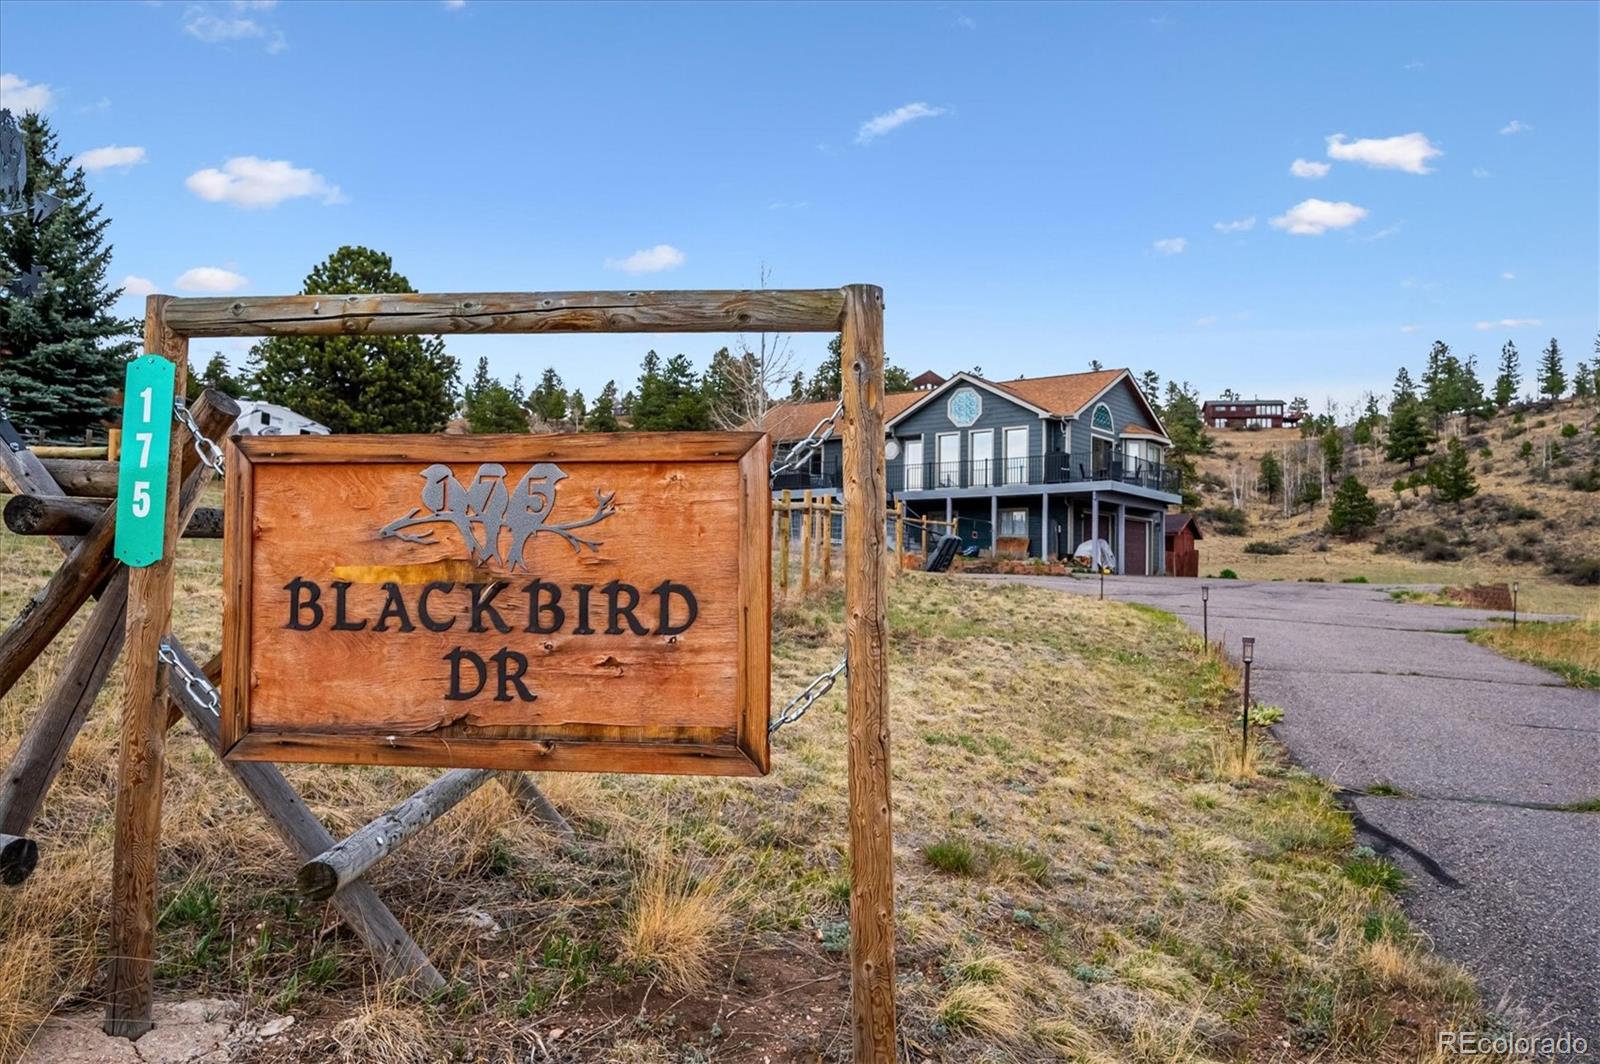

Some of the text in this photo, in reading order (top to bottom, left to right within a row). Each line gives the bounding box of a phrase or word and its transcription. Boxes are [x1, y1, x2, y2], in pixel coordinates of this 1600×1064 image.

[132, 387, 153, 518] 175
[435, 474, 548, 513] 175
[282, 576, 698, 636] BLACKBIRD
[442, 645, 538, 702] DR
